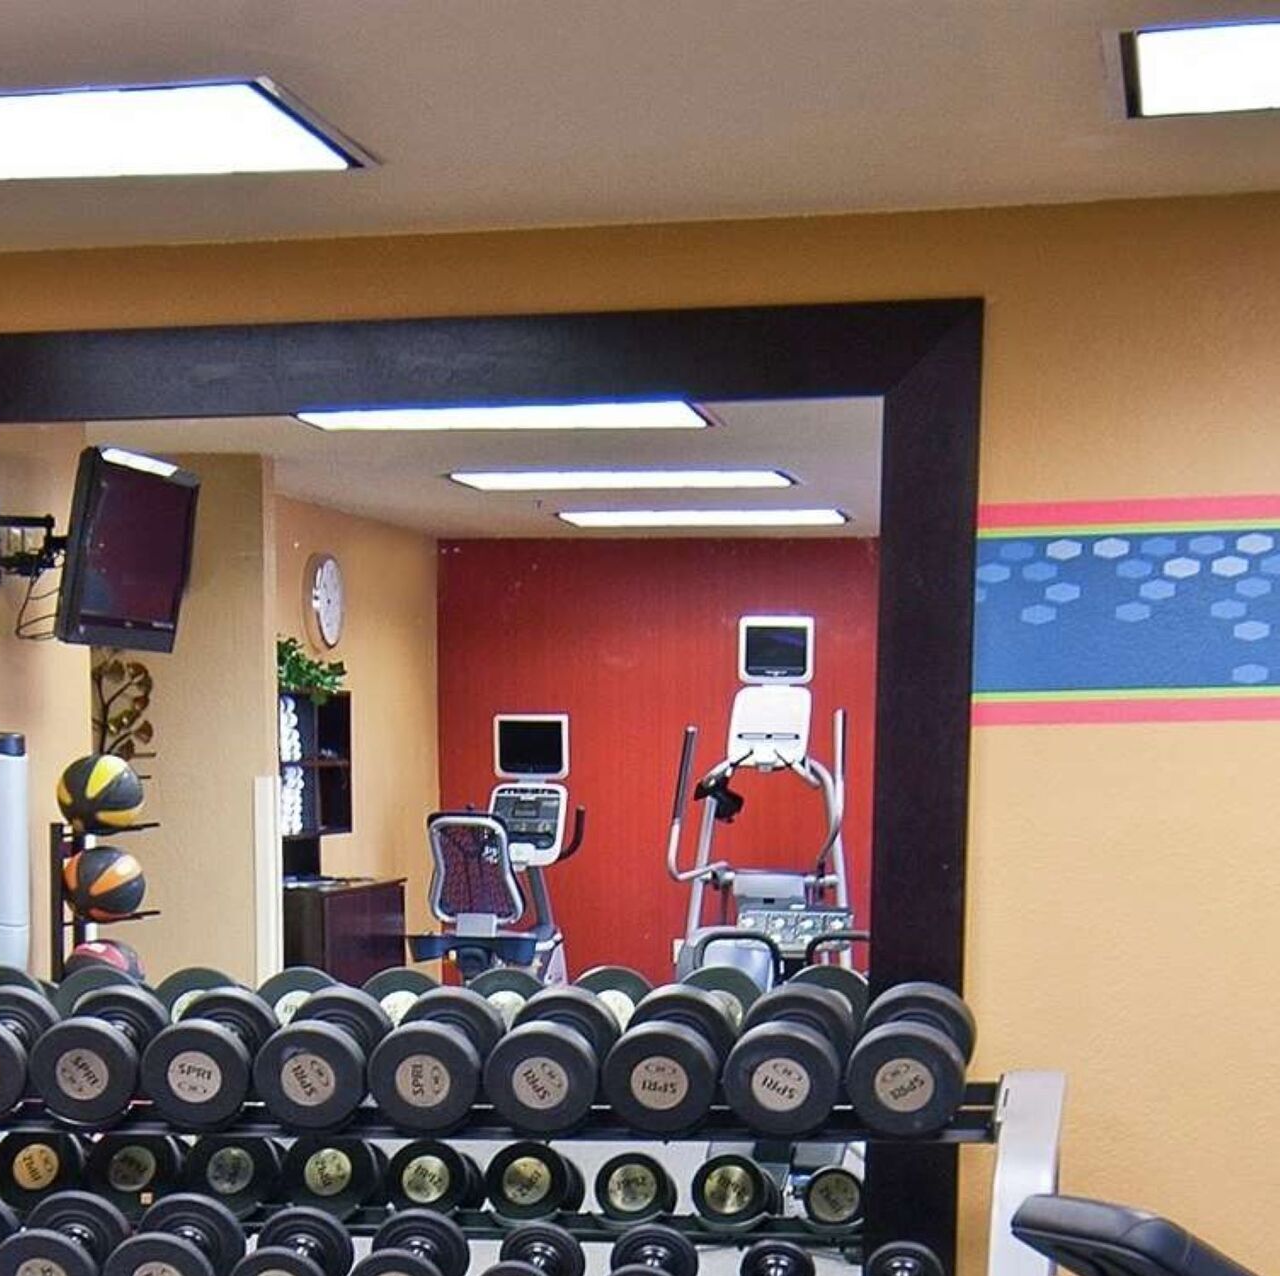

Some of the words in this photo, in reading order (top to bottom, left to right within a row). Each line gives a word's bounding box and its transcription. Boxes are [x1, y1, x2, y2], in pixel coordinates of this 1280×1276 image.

[177, 1062, 213, 1081] SPRI
[291, 1063, 316, 1098] SPRI
[410, 1063, 425, 1097] SPRI
[522, 1069, 550, 1101] SPRI
[640, 1078, 677, 1094] SPRI
[761, 1075, 796, 1100] SPRI
[889, 1074, 925, 1101] SPRI
